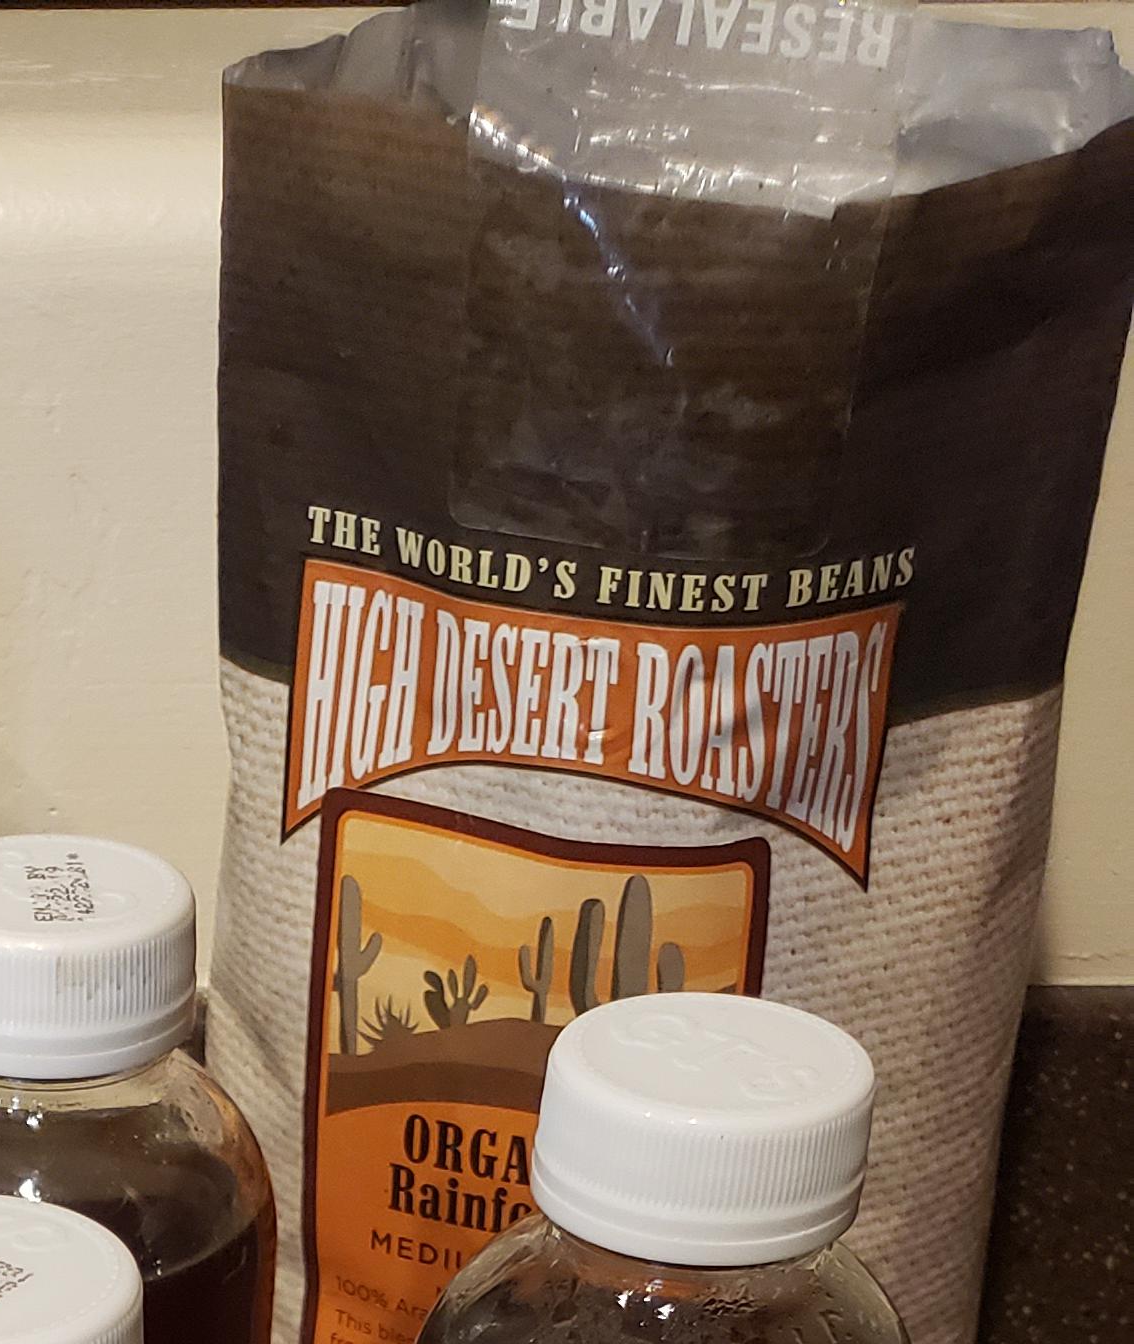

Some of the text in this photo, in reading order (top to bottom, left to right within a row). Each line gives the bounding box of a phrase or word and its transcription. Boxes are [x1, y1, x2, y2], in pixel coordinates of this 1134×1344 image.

[489, 0, 897, 67] RESEALABLE
[307, 505, 916, 613] THE WORLD'S FINEST BEANS
[297, 580, 888, 855] HIGH DESERT ROASTERS
[334, 1308, 372, 1335] This
[335, 1275, 389, 1309] 100%
